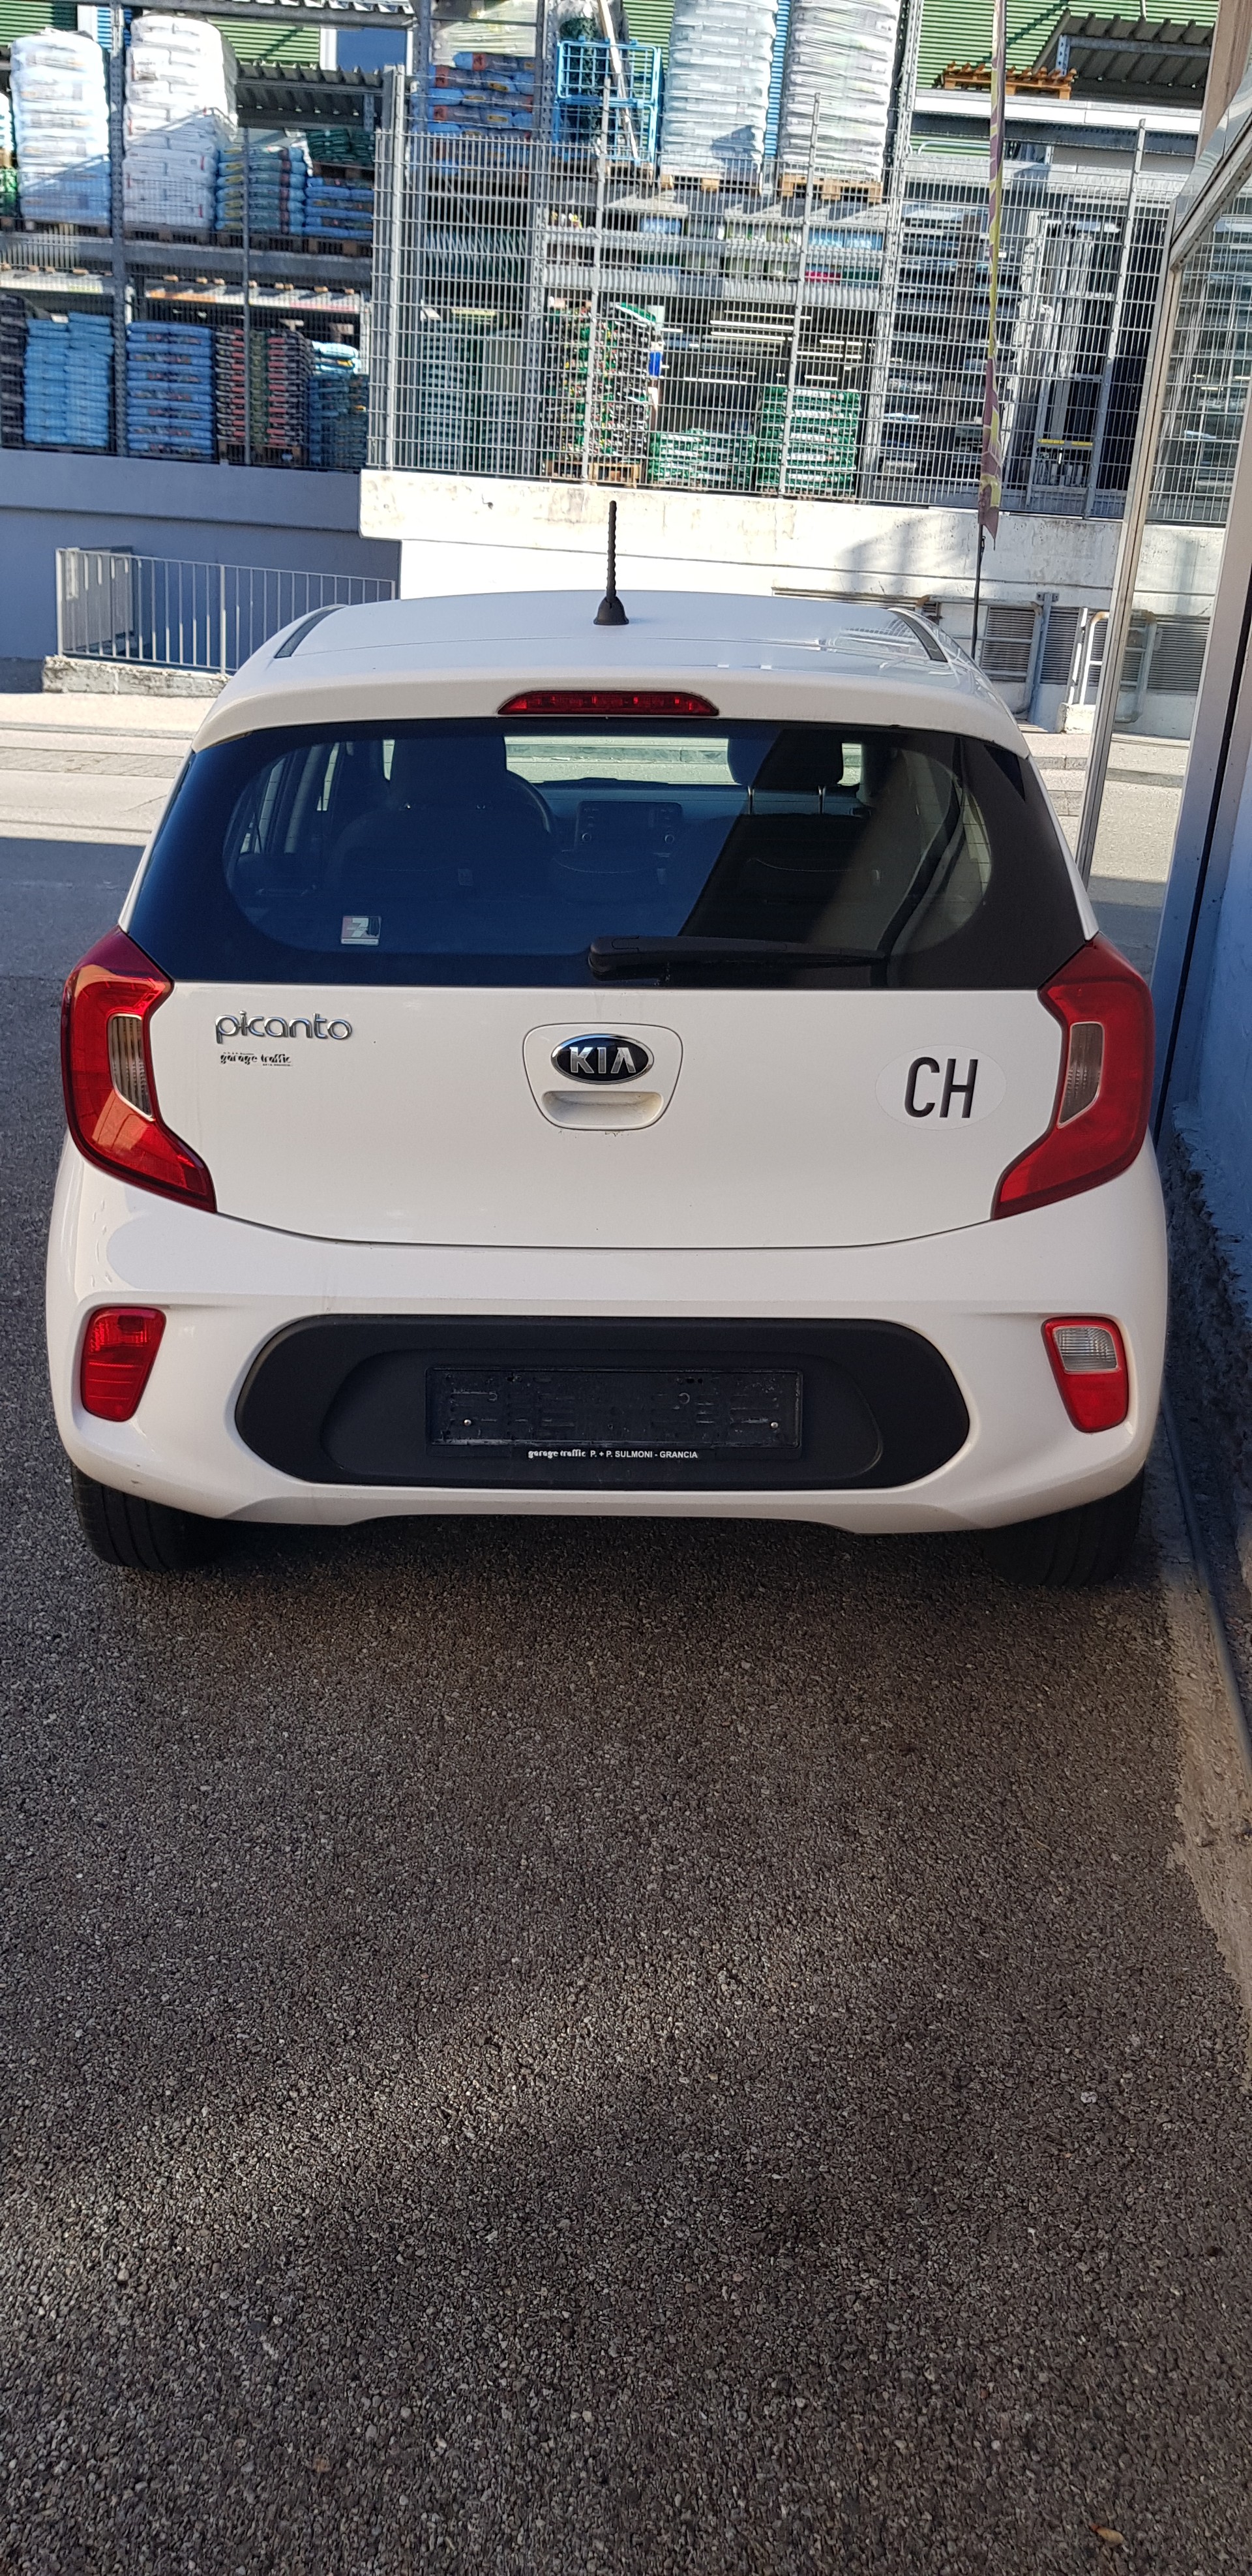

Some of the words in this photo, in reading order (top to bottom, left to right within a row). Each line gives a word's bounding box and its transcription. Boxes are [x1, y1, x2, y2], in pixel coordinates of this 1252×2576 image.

[215, 1010, 352, 1044] picanto
[220, 1055, 258, 1065] garage
[261, 1053, 291, 1063] traffic
[569, 1046, 636, 1074] KIA
[904, 1057, 979, 1118] CH
[528, 1450, 559, 1459] garage
[560, 1449, 586, 1457] traffic
